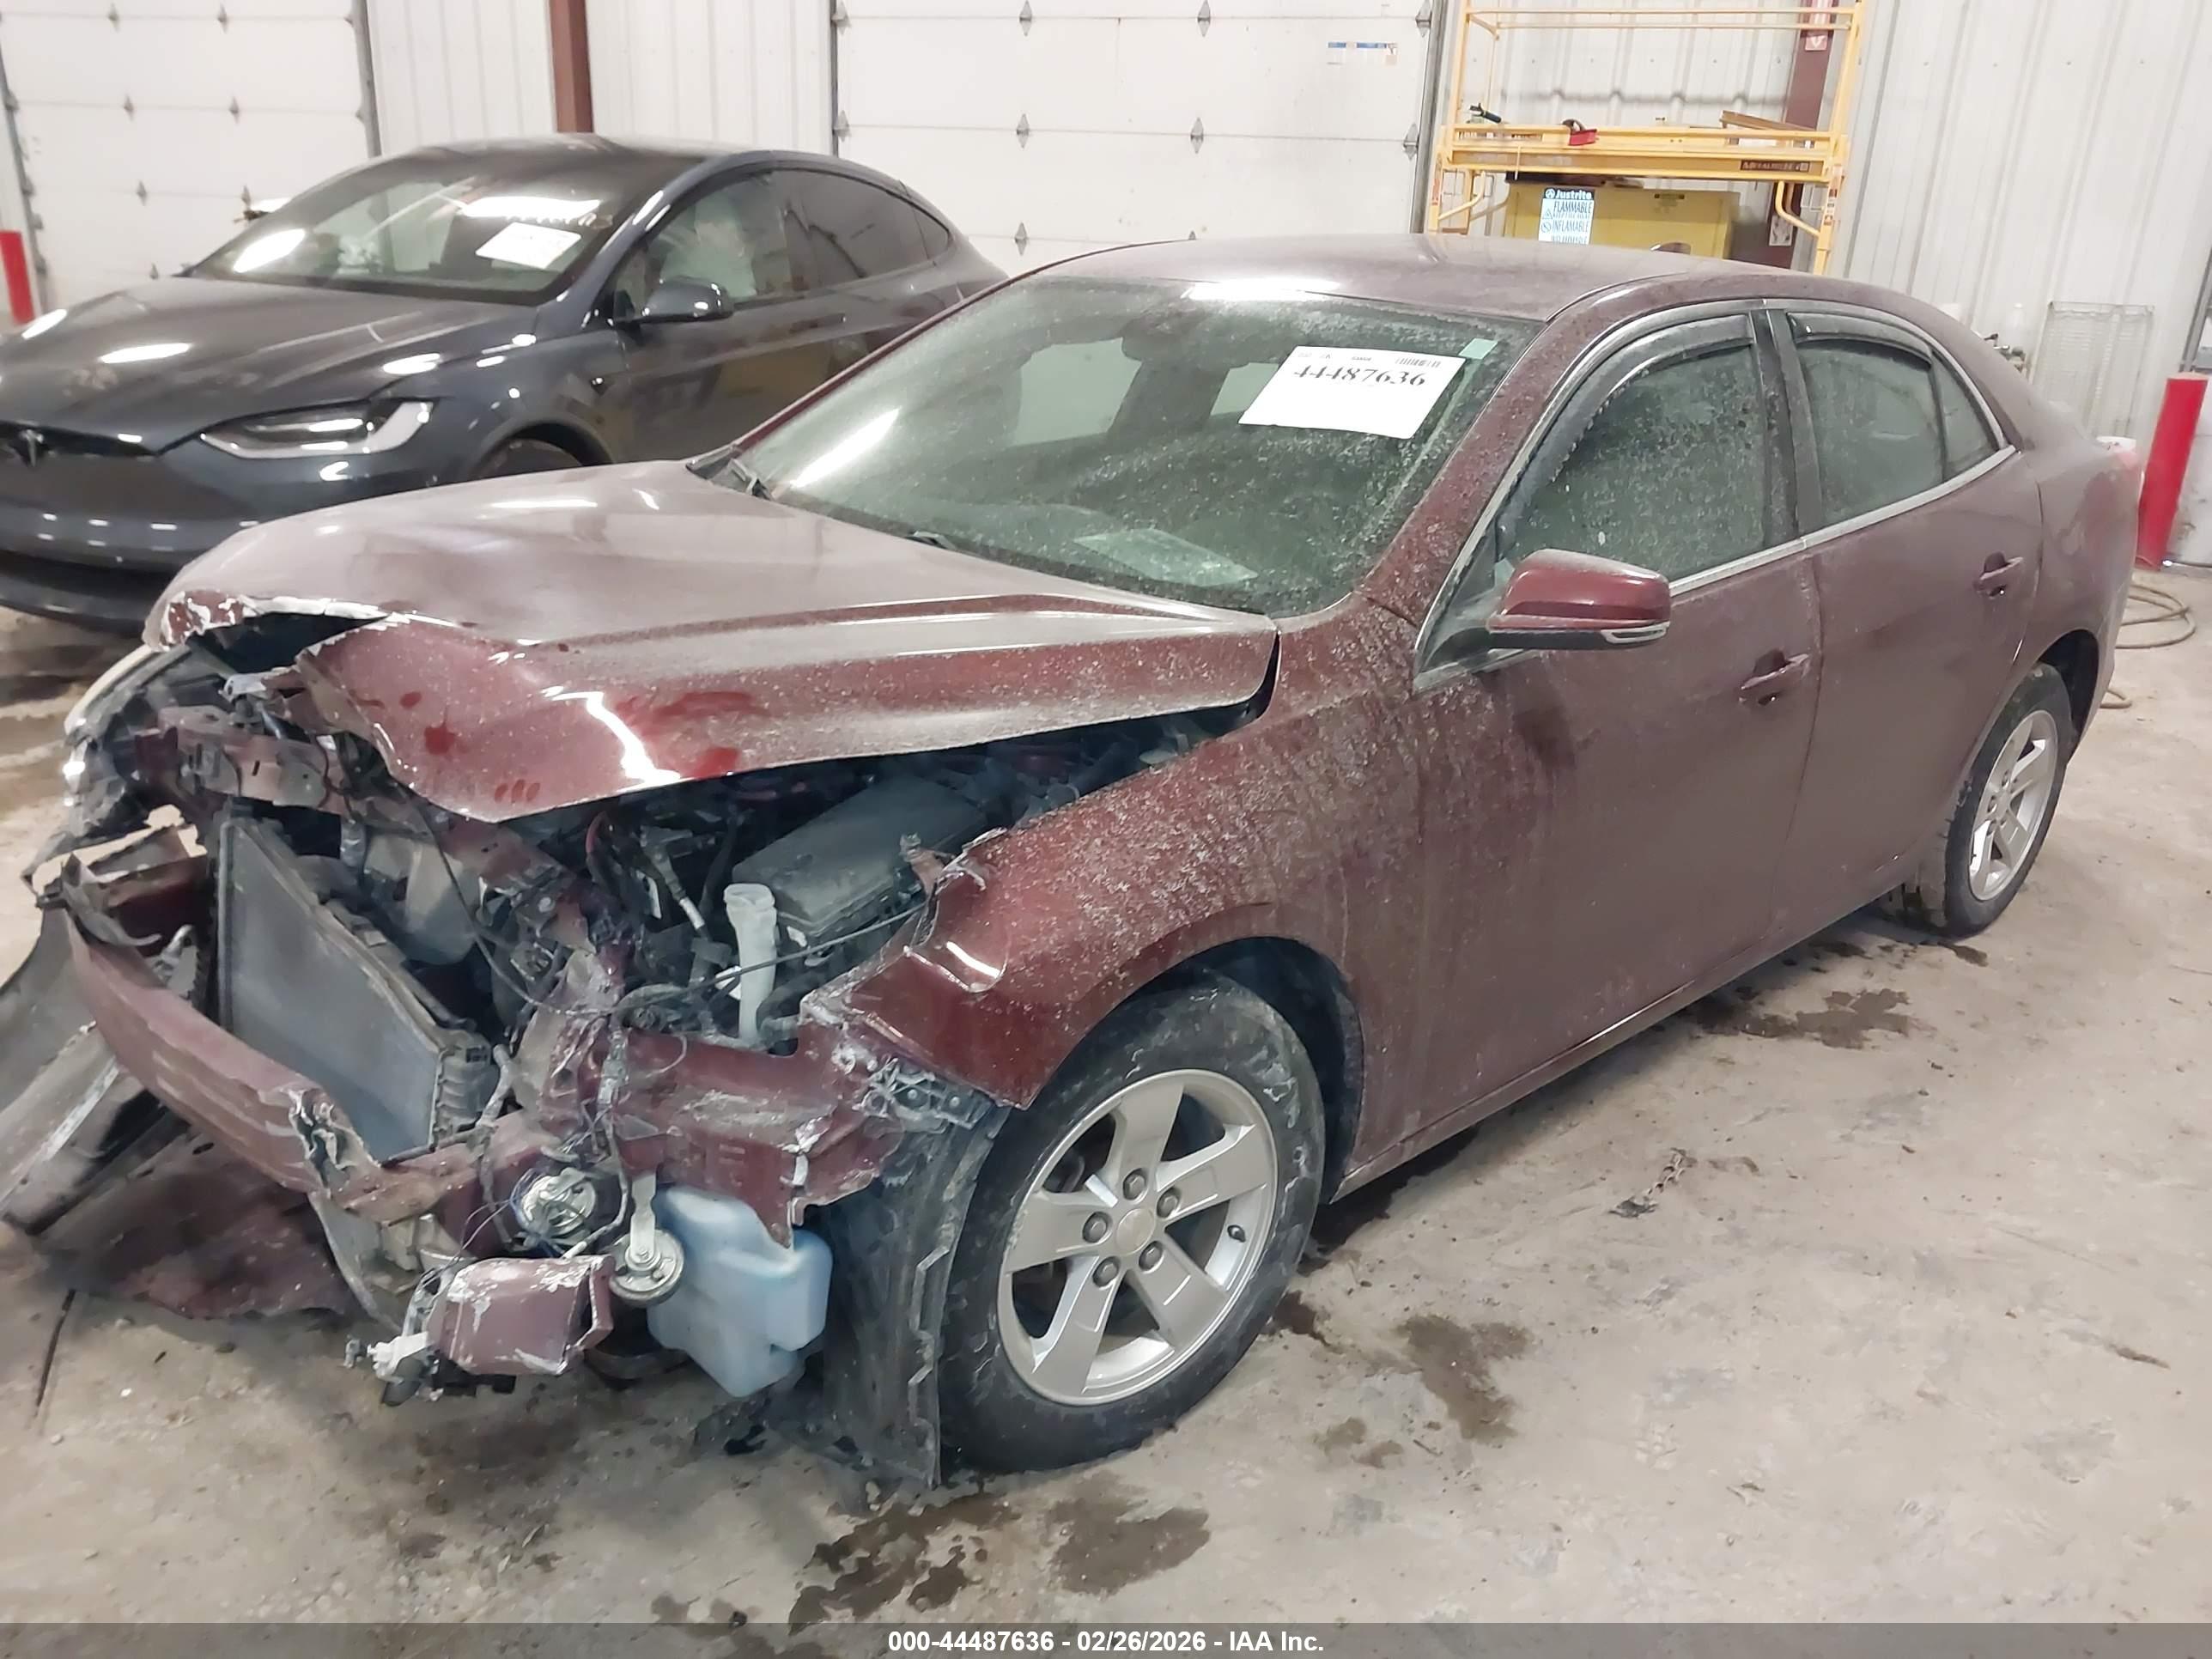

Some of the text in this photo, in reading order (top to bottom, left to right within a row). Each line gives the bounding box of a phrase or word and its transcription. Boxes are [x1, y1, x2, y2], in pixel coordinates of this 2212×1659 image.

[1555, 189, 1592, 200] Justrite
[1553, 200, 1593, 214] FLAMMABLE
[1293, 364, 1426, 386] 44487636
